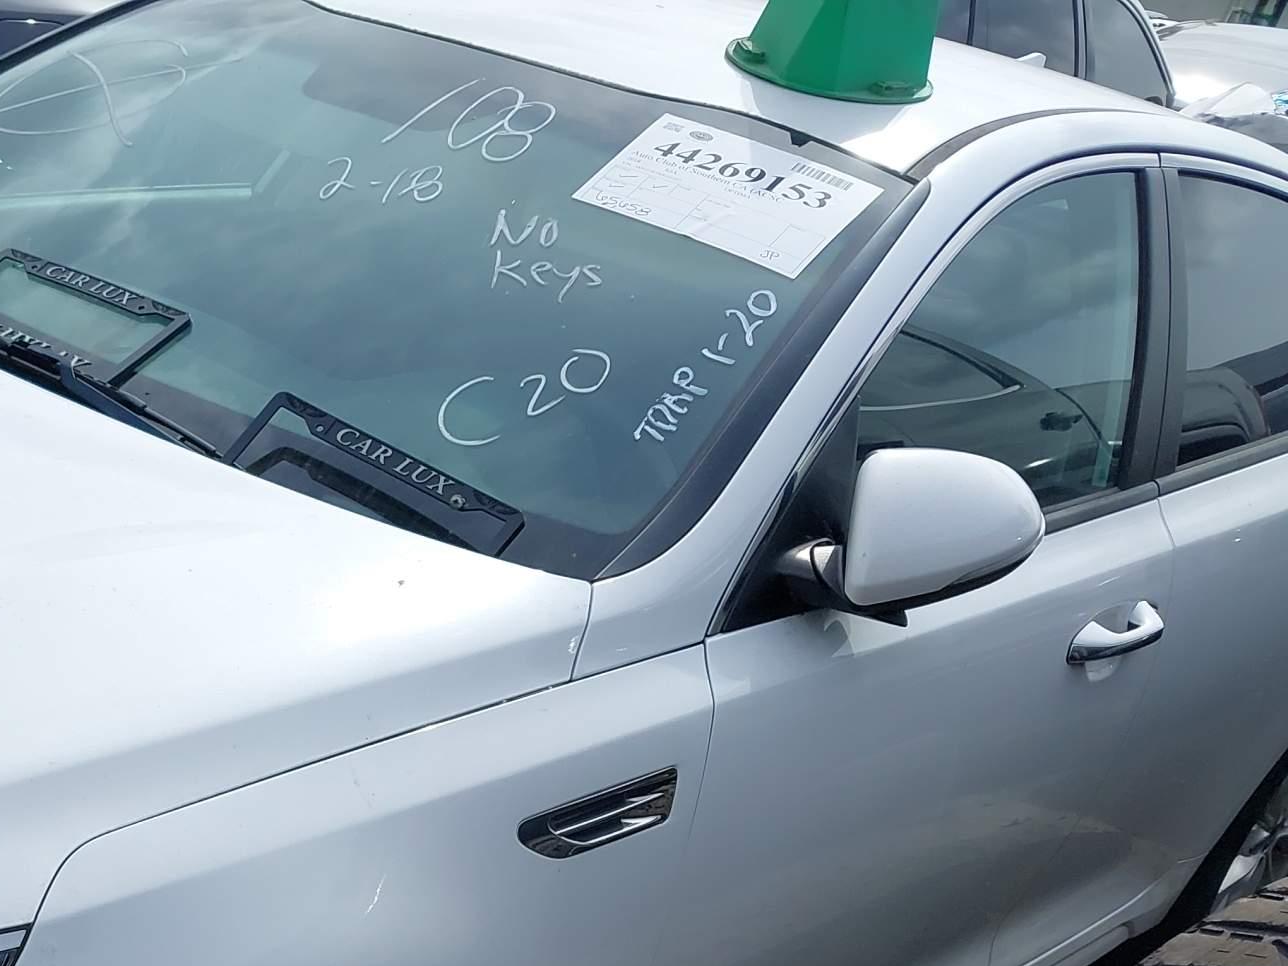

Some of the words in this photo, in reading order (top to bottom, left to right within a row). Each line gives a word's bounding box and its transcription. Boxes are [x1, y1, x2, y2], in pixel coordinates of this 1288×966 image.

[381, 78, 556, 162] 108
[632, 149, 654, 162] Auto
[655, 156, 679, 170] Club
[689, 166, 731, 186] Southern
[653, 142, 832, 209] 44269153
[45, 266, 90, 288] CAR
[90, 280, 137, 305] LUX
[759, 249, 781, 261] JP
[701, 289, 778, 365] 1-20
[335, 427, 394, 465] CAR
[392, 457, 455, 496] LUX
